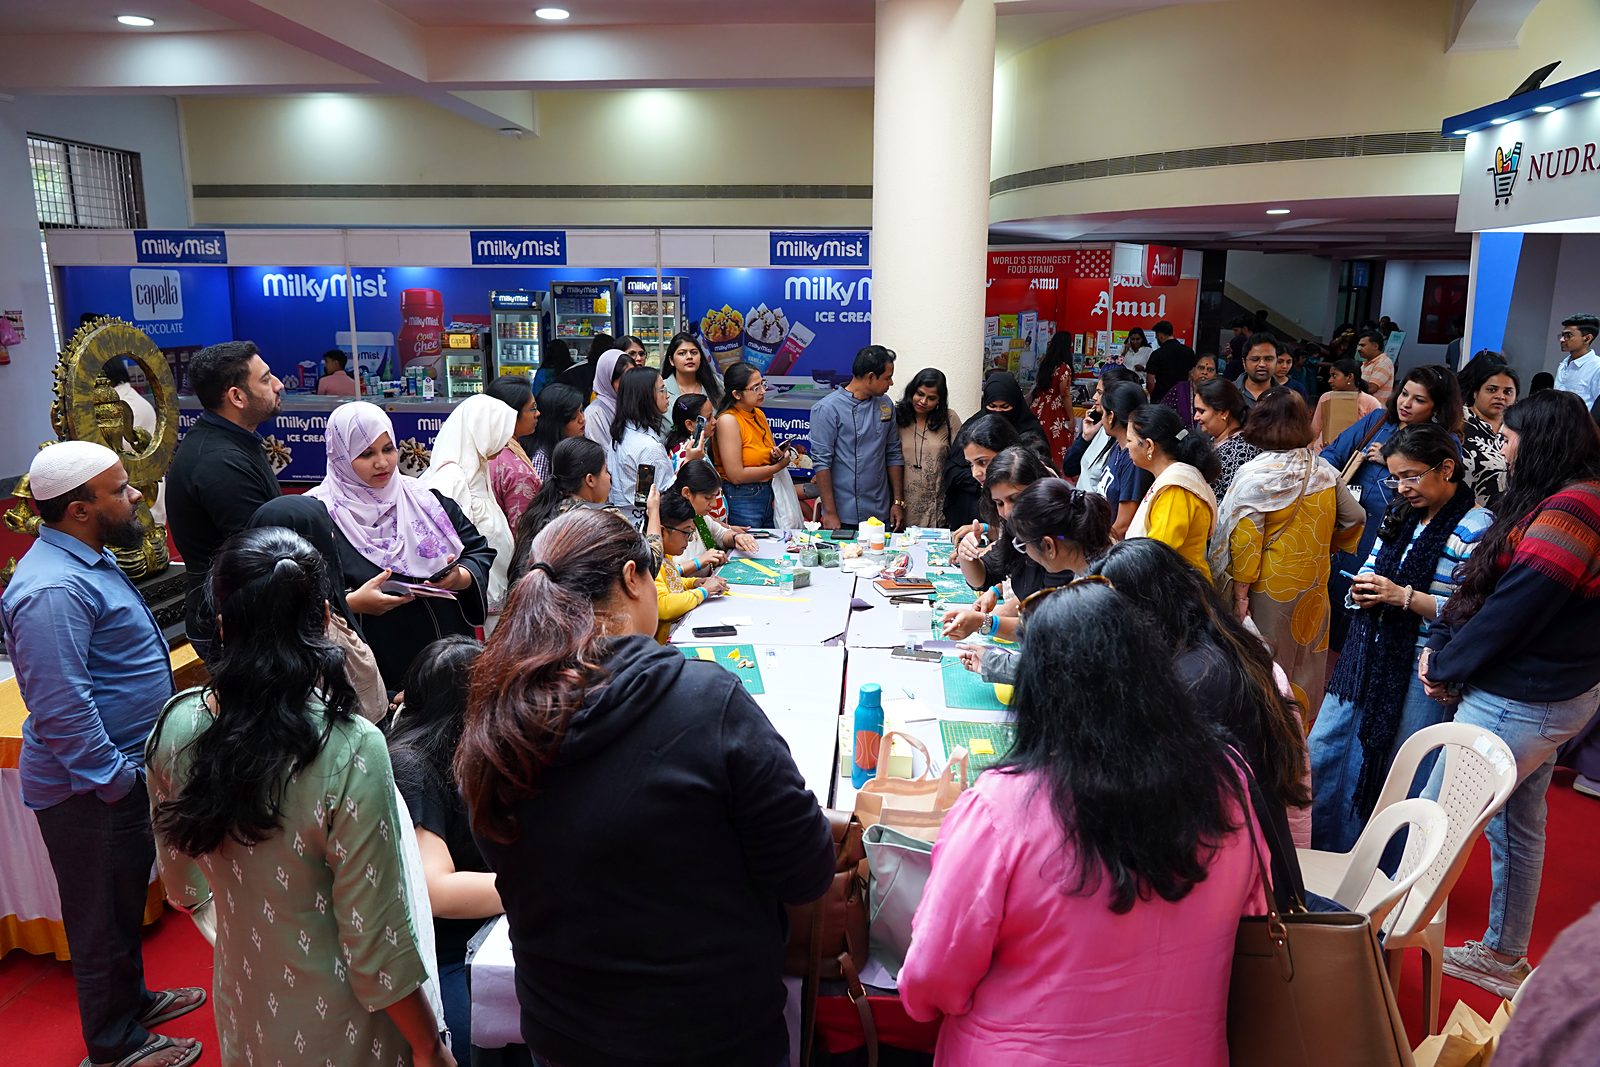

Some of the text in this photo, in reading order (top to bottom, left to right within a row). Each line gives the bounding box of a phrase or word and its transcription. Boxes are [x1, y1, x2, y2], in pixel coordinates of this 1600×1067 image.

[1527, 143, 1600, 181] NUDR
[992, 255, 1071, 265] WORLD'S STRONGEST
[1152, 253, 1177, 277] Amul
[1007, 265, 1054, 274] FOOD BRAND
[136, 275, 178, 314] capella
[785, 276, 872, 306] MilkyM
[1091, 290, 1167, 318] Amul
[815, 311, 872, 323] ICE CREA
[416, 332, 434, 341] Cow
[413, 340, 439, 356] Ghee
[766, 417, 810, 431] MilkyMis
[286, 434, 326, 443] ICE CREA
